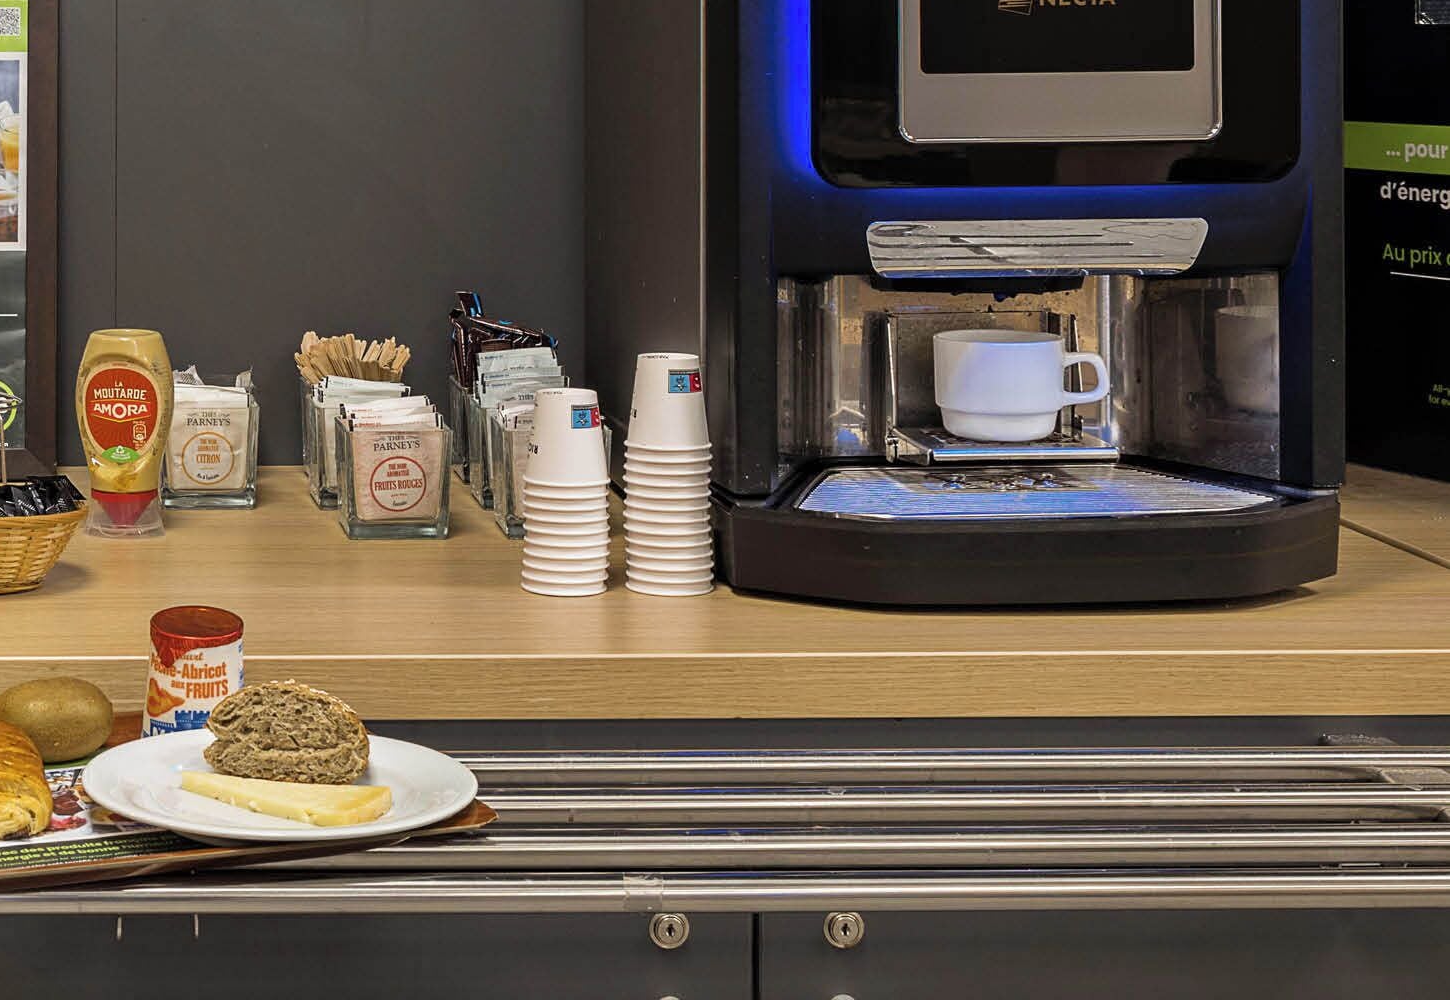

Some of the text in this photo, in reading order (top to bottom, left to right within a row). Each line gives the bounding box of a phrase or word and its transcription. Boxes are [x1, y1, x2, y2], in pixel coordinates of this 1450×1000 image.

[1404, 142, 1448, 162] pour
[1380, 181, 1450, 210] d'énerg
[1382, 243, 1405, 261] Au
[1410, 246, 1442, 269] prix
[94, 388, 147, 400] MOUTARDE
[94, 403, 148, 419] AMORA
[187, 418, 231, 426] PARNEY'S
[373, 440, 421, 452] PARNEY'S
[196, 454, 221, 464] CITRON
[374, 479, 423, 491] FRUITS ROUGES
[171, 679, 229, 699] aux FRUITS
[46, 841, 103, 852] produits
